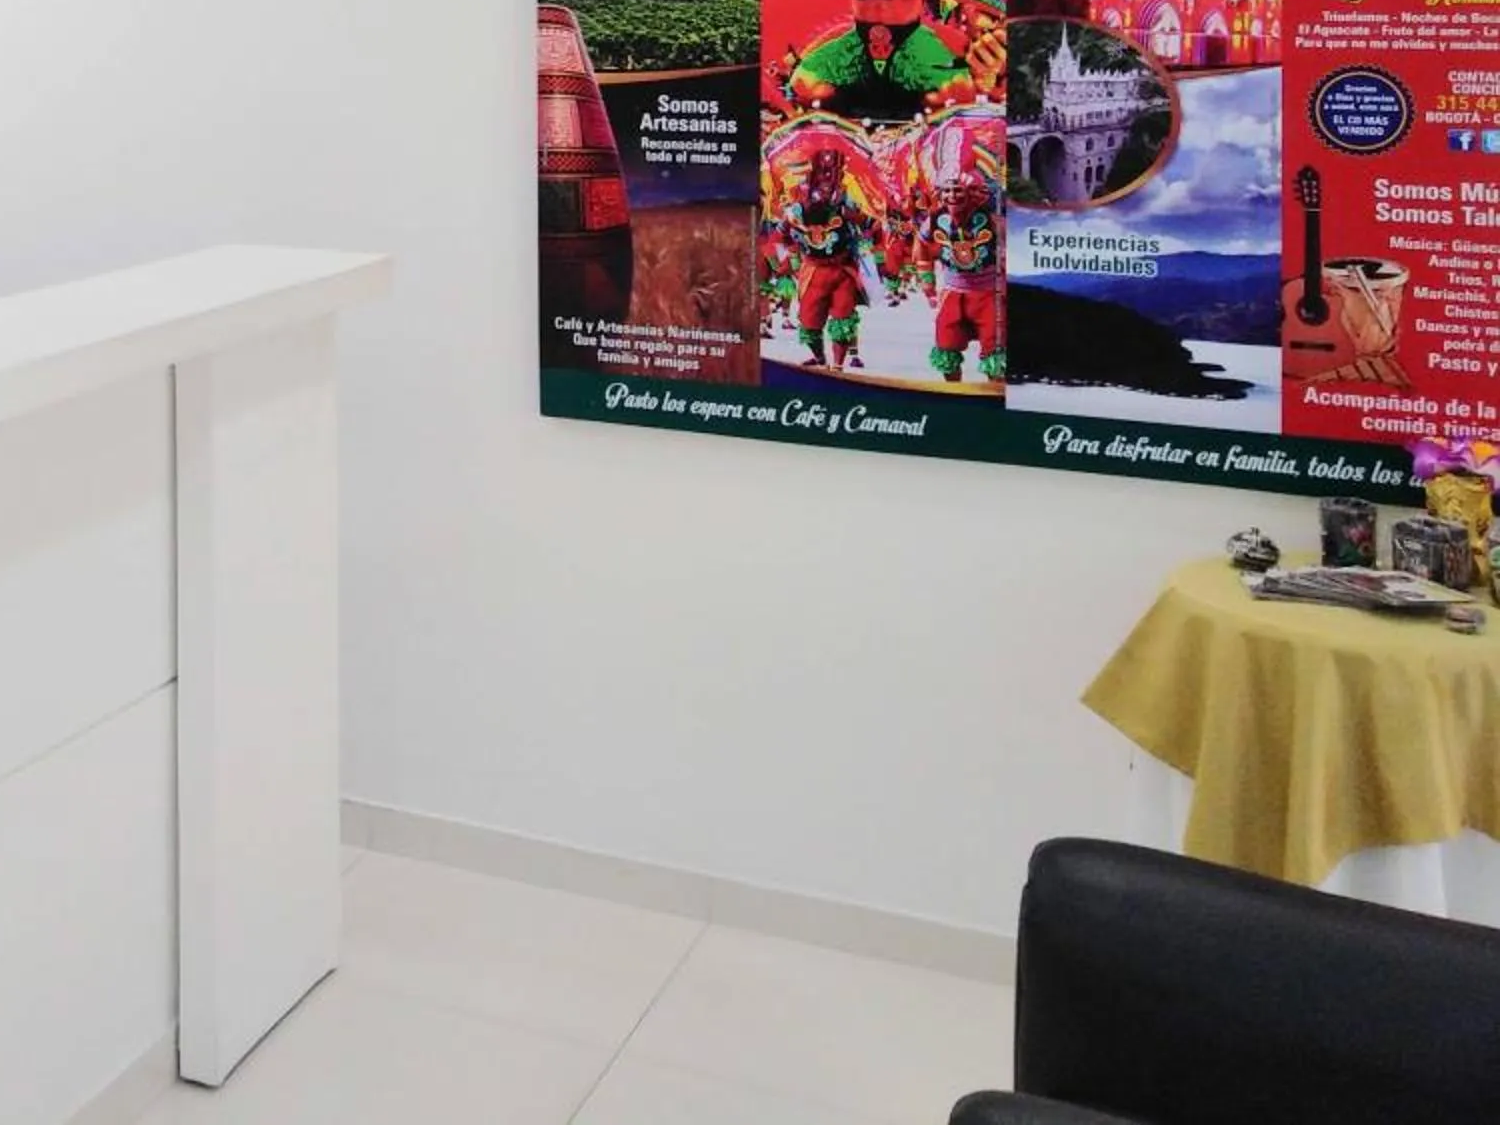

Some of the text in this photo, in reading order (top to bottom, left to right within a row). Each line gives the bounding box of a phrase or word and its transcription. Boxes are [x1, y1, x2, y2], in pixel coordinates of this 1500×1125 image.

[657, 93, 720, 115] Somos
[1436, 95, 1469, 110] 315
[639, 112, 738, 134] Artesanías
[1373, 177, 1454, 201] Somos
[1375, 201, 1454, 225] Somos
[1029, 228, 1161, 253] Experiencias
[1032, 251, 1157, 275] Inolvidables
[1415, 318, 1469, 334] Danzas
[573, 333, 598, 347] Que
[1427, 353, 1499, 377] Pasto y
[605, 382, 929, 437] Pasto los espera con Café y Carnaval
[1303, 386, 1497, 420] Acompañado de la
[1361, 415, 1438, 436] comida
[1043, 425, 1100, 456] Para
[1104, 434, 1193, 464] disfrutar
[1195, 449, 1221, 467] en
[1307, 456, 1366, 481] todos
[1370, 461, 1404, 487] los
